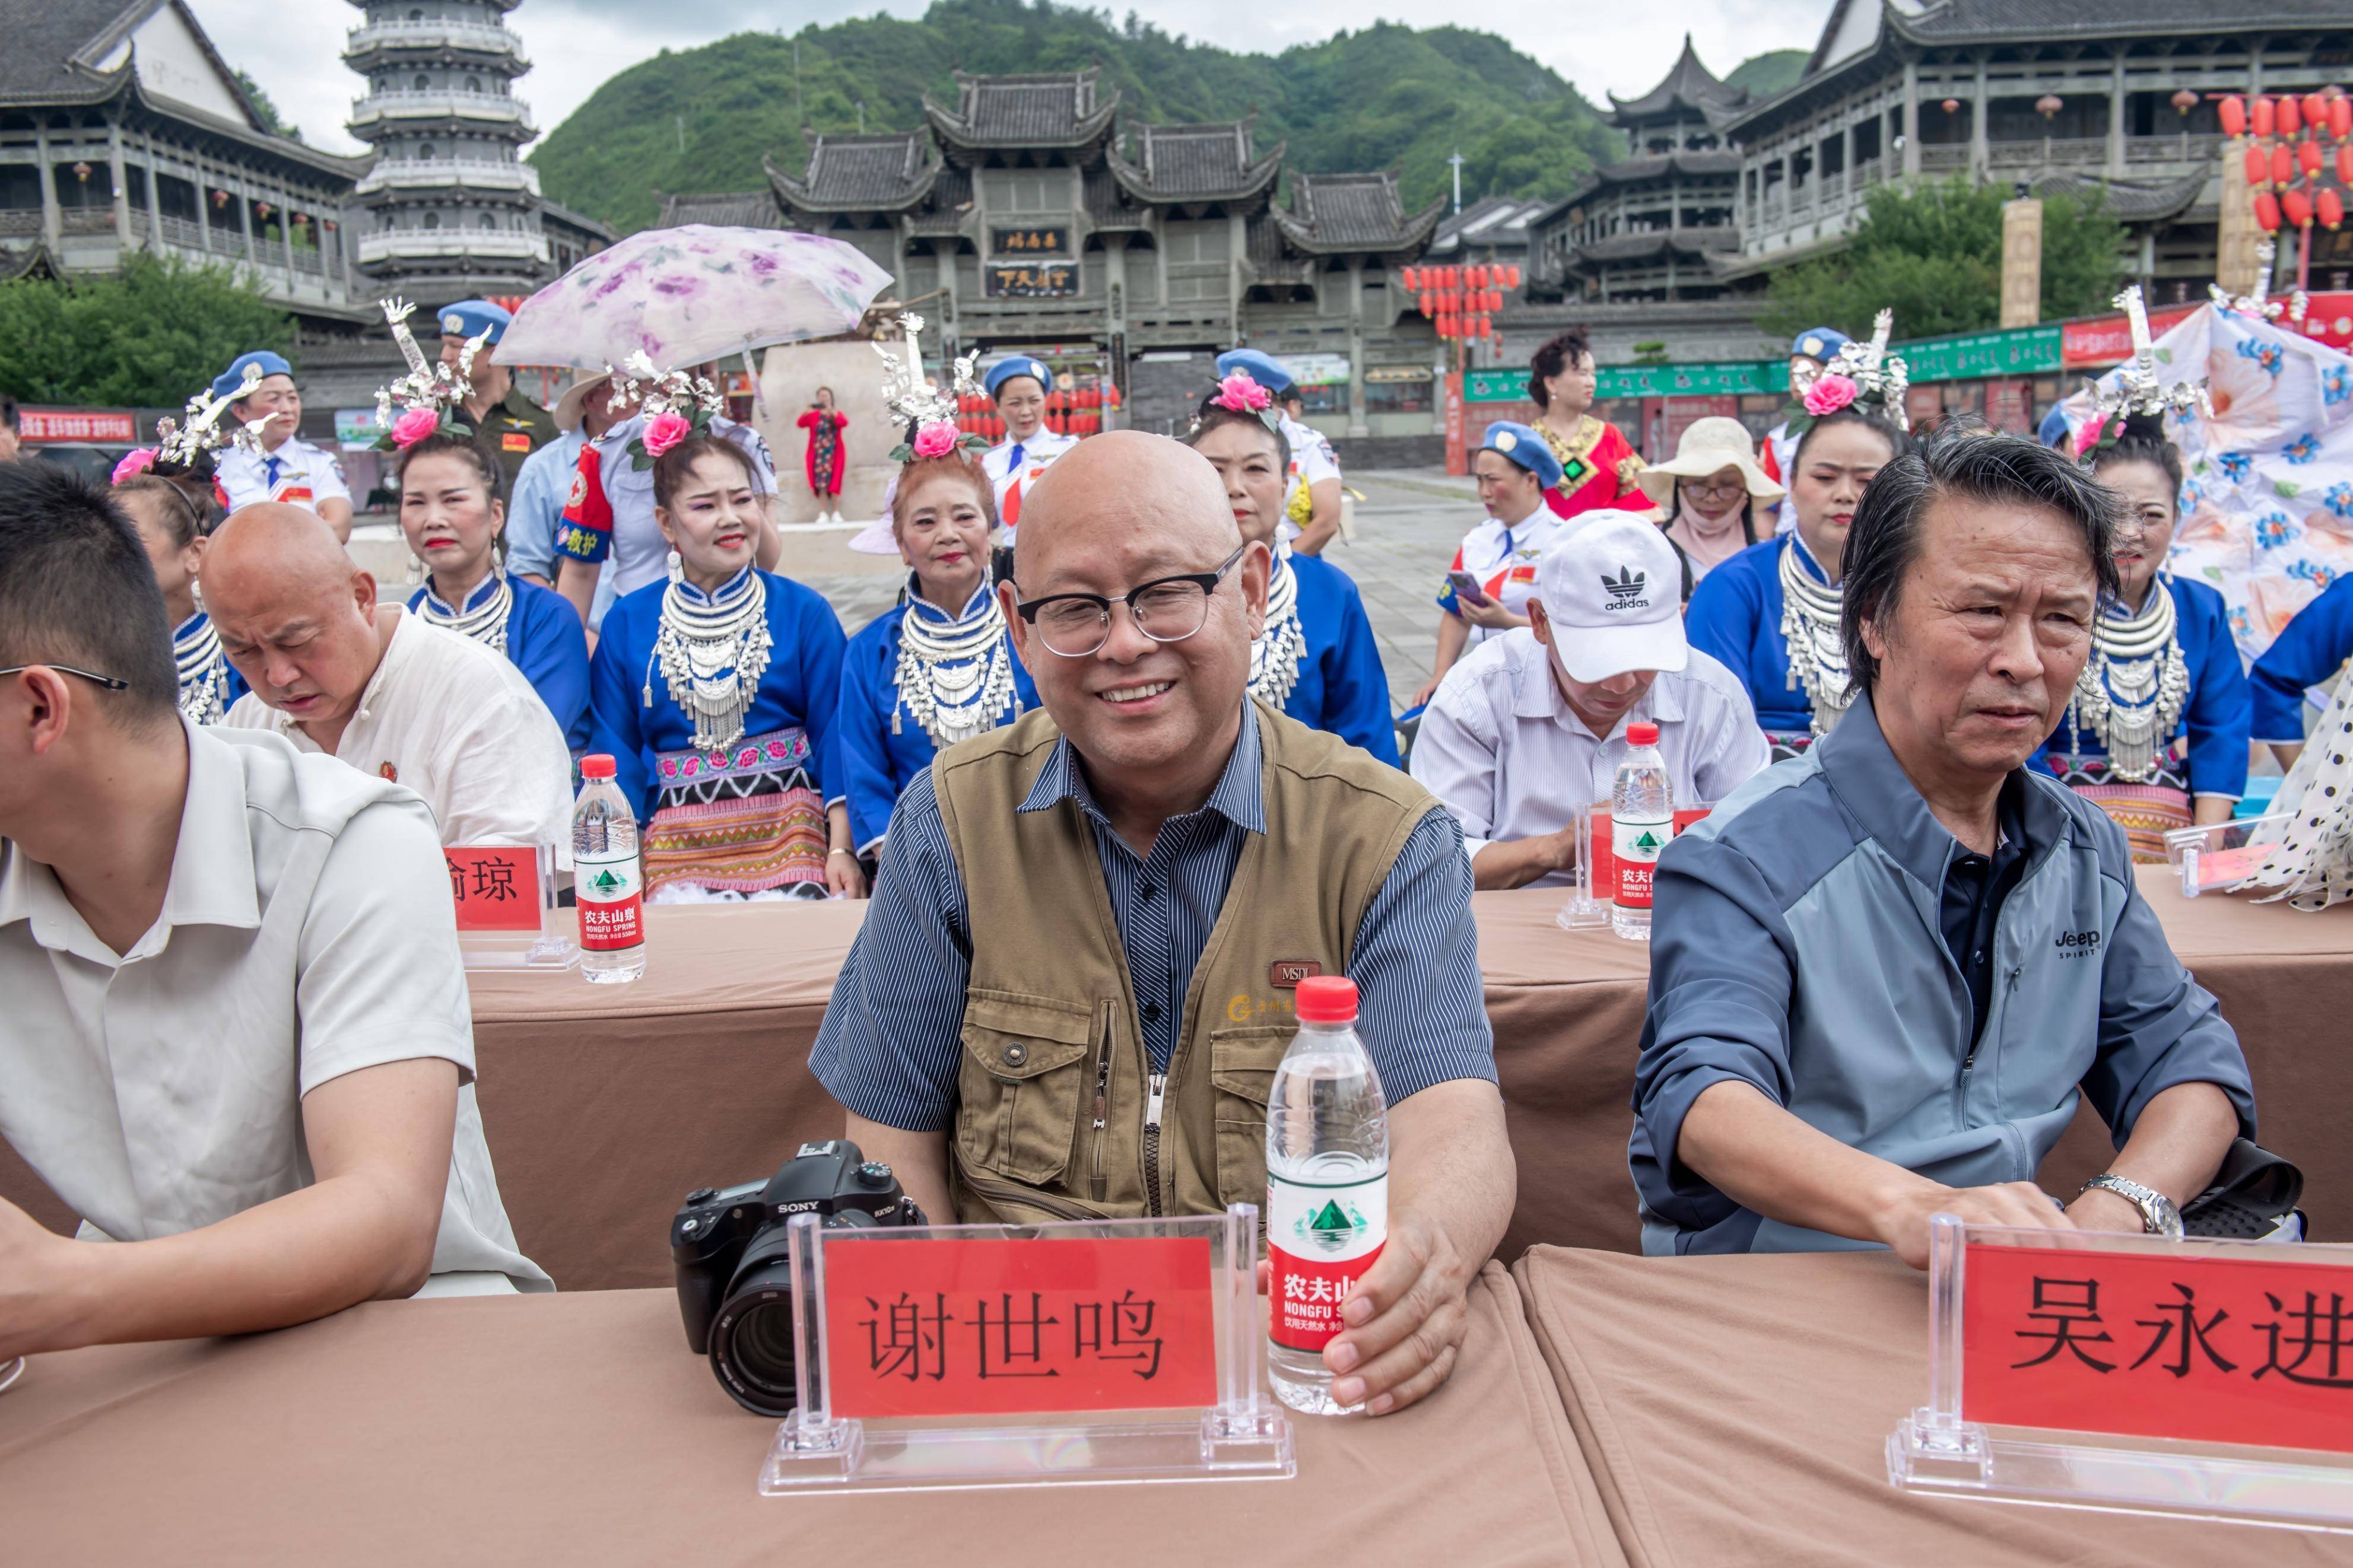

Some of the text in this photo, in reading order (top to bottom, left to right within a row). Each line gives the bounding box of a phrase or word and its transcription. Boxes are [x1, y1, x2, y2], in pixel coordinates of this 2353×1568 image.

[567, 527, 598, 556] 救护
[1605, 598, 1649, 610] adidas
[1622, 883, 1647, 891] NONGFU
[585, 907, 635, 925] 农夫山泉
[586, 921, 636, 933] NONGFU SPRING
[2055, 930, 2101, 947] Jeep
[2059, 949, 2095, 959] SPIRIT
[778, 1201, 819, 1213] SONY
[1284, 1300, 1332, 1319] NONGFU
[1284, 1315, 1326, 1332] 饮用天然水
[857, 1289, 1163, 1382] 谢世鸣
[2010, 1276, 2353, 1389] 吴永进
